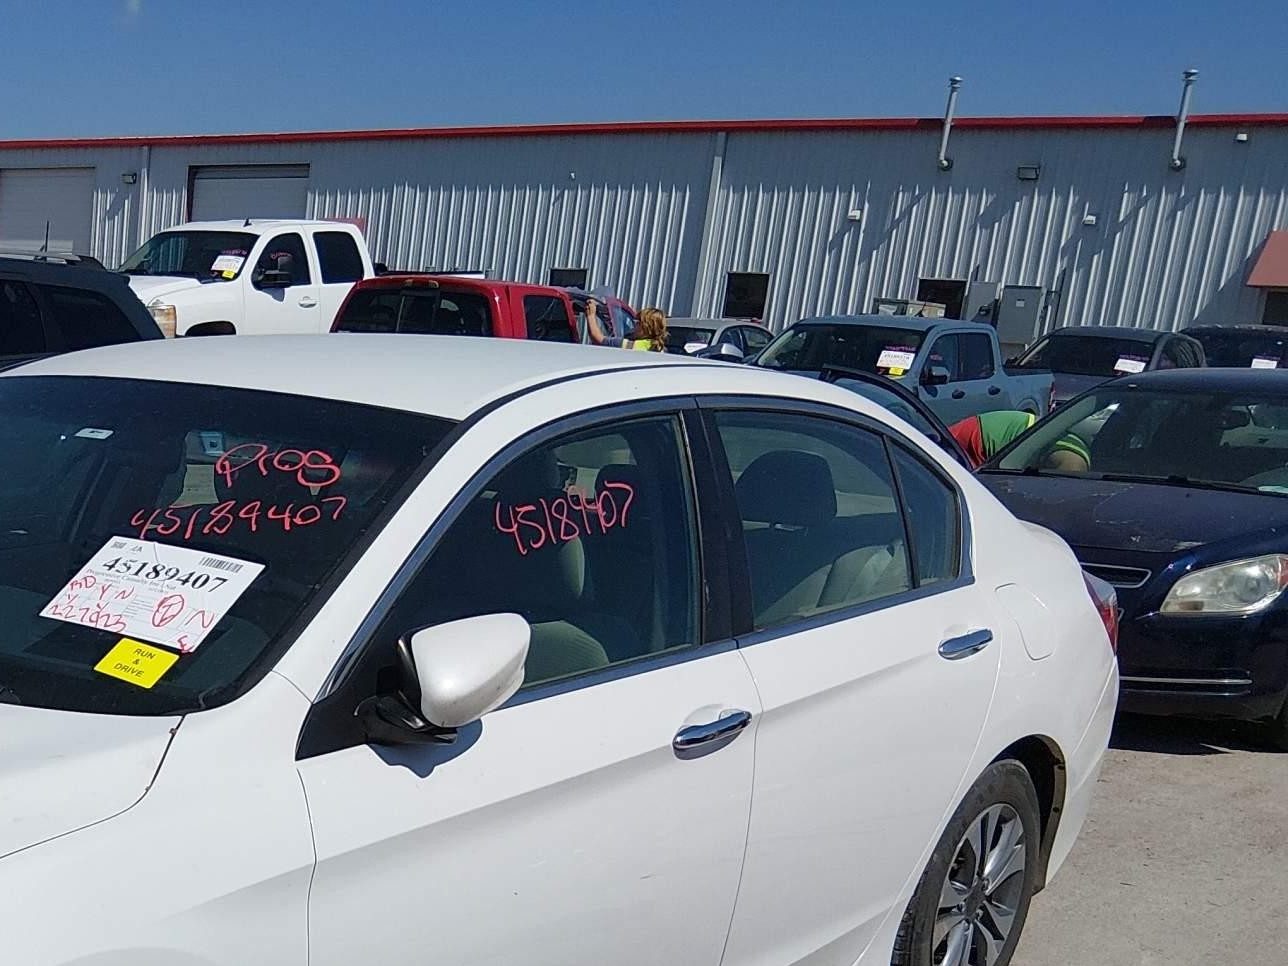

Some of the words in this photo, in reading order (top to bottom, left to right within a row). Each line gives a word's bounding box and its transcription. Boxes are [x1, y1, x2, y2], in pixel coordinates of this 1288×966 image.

[102, 556, 229, 593] 45189407
[132, 648, 156, 660] RUN
[132, 658, 141, 666] &
[113, 662, 145, 678] DRIVE
